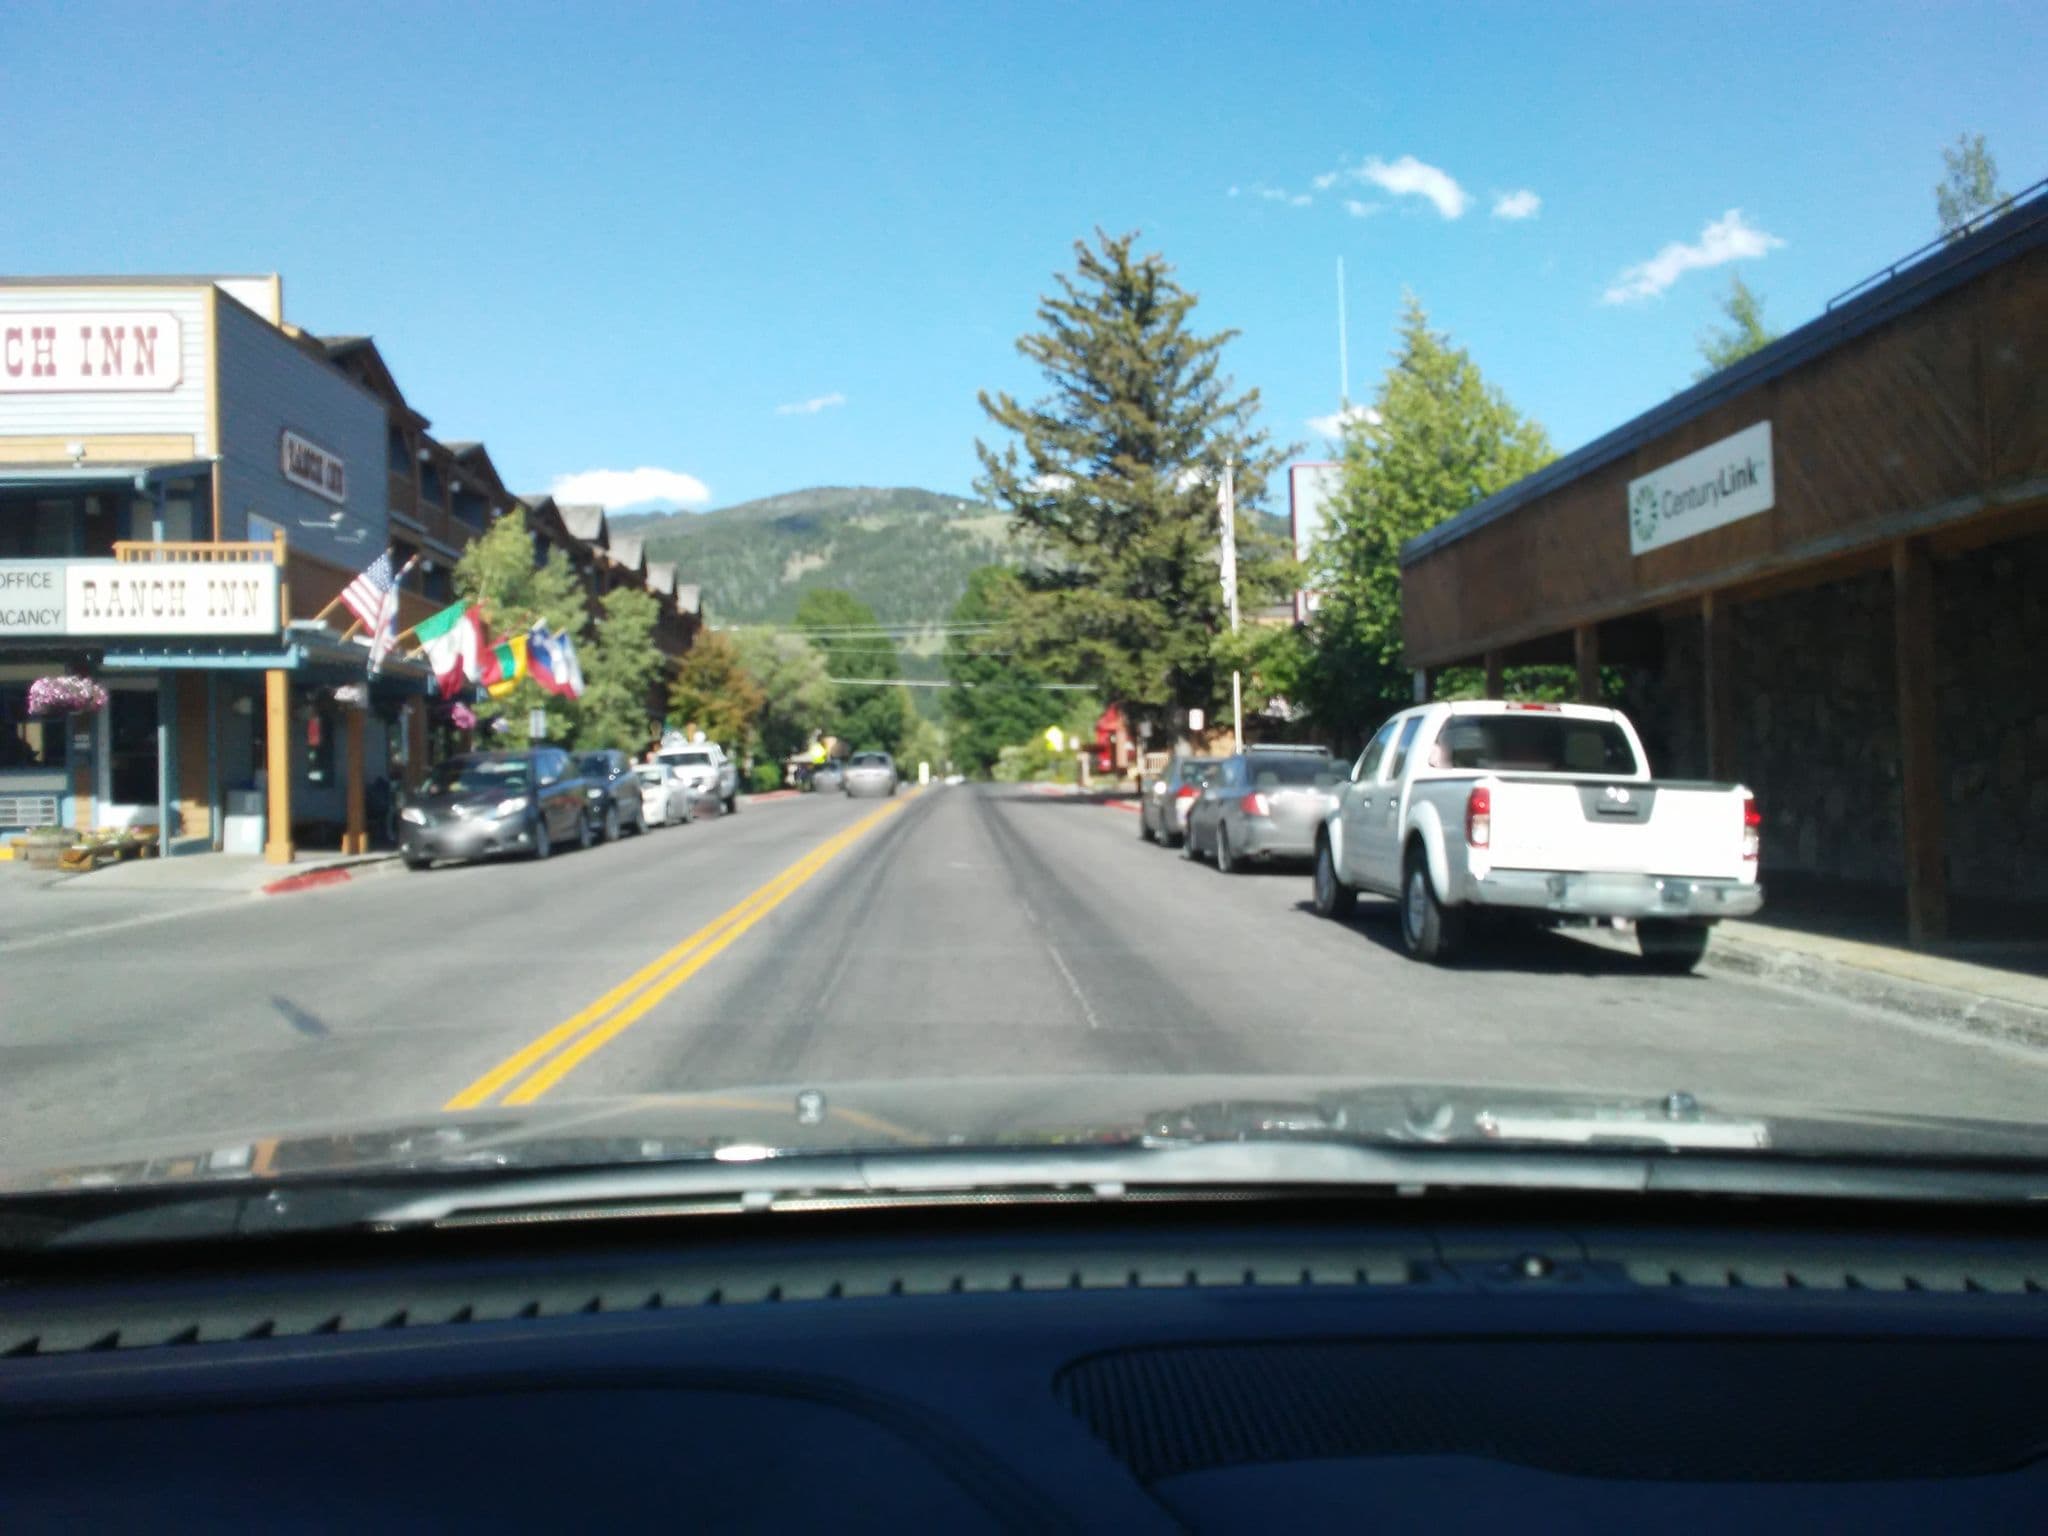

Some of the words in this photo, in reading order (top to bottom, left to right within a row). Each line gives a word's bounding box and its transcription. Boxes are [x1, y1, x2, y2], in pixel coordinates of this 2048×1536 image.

[5, 327, 56, 377] CH
[80, 326, 158, 376] INN
[1662, 456, 1758, 519] CenturyLink
[83, 580, 186, 617] RANCH
[208, 580, 259, 617] INN
